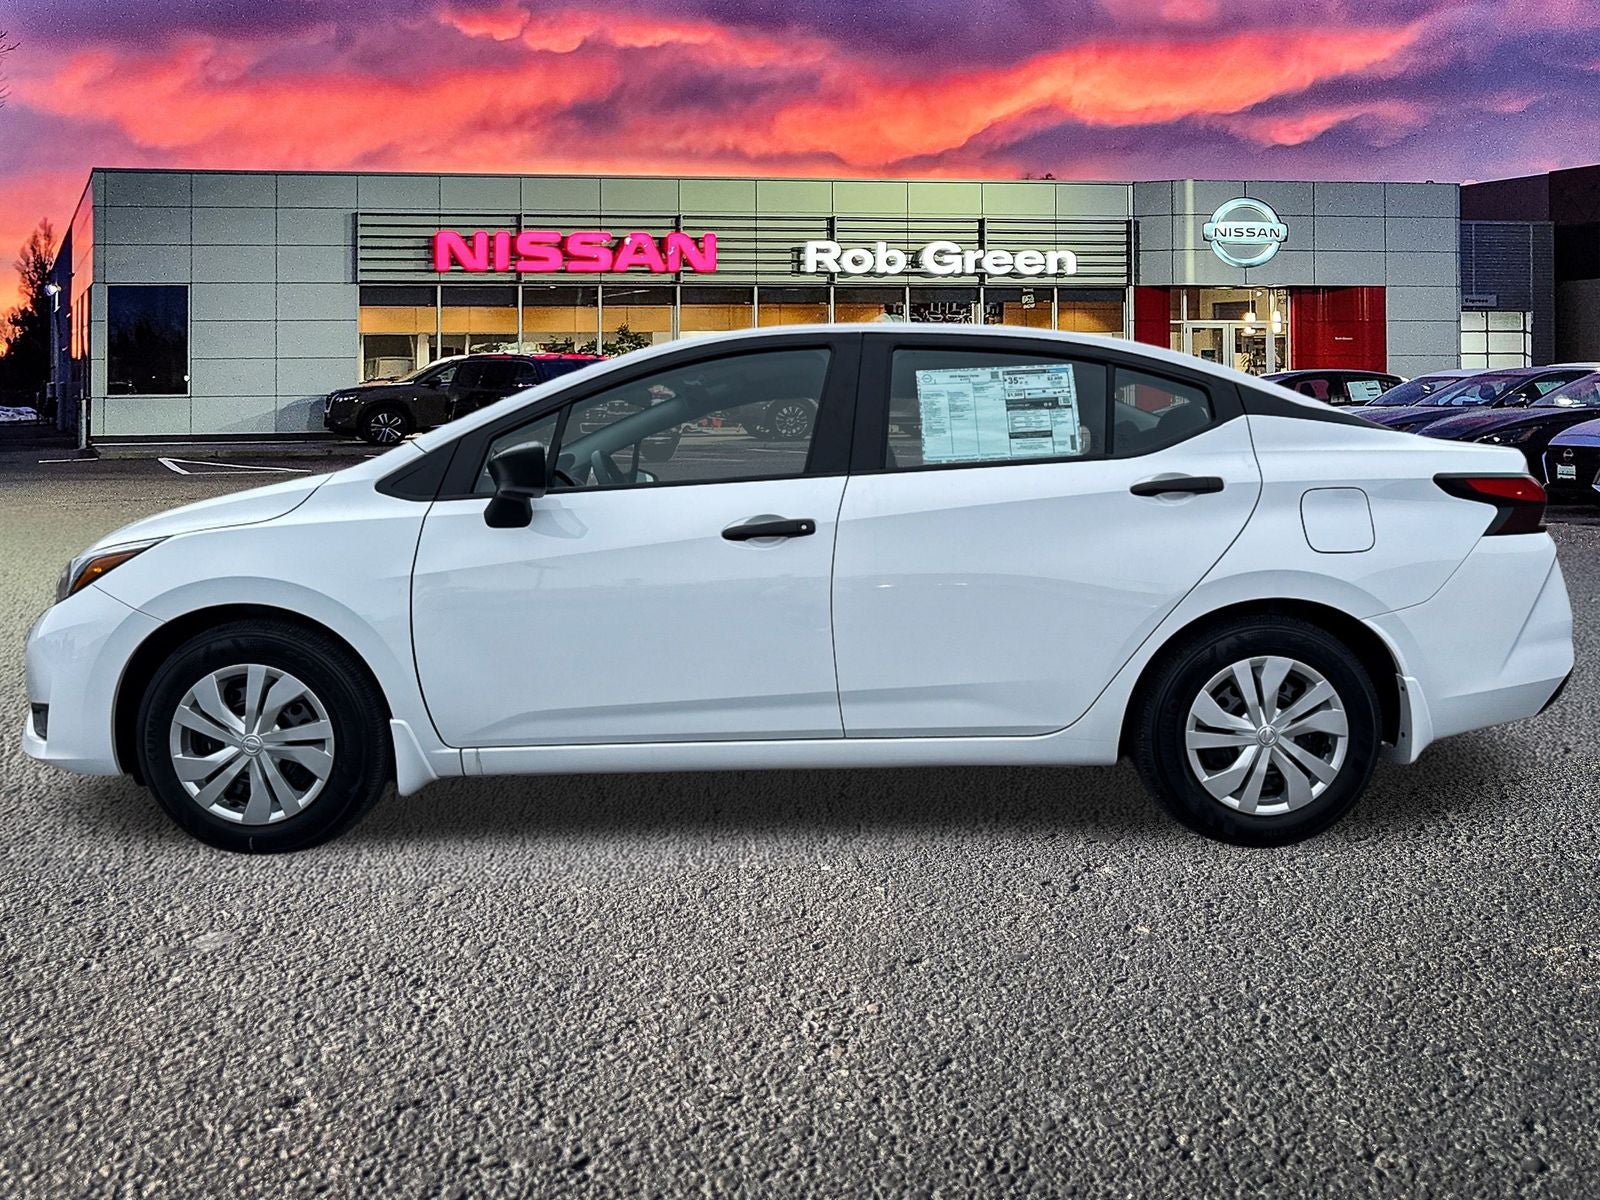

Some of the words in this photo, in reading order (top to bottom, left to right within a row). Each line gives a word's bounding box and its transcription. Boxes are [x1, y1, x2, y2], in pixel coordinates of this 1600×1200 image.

[1214, 227, 1280, 238] NISSAN
[433, 230, 718, 273] NISSAN
[804, 240, 907, 275] Rob
[922, 241, 1078, 275] Green
